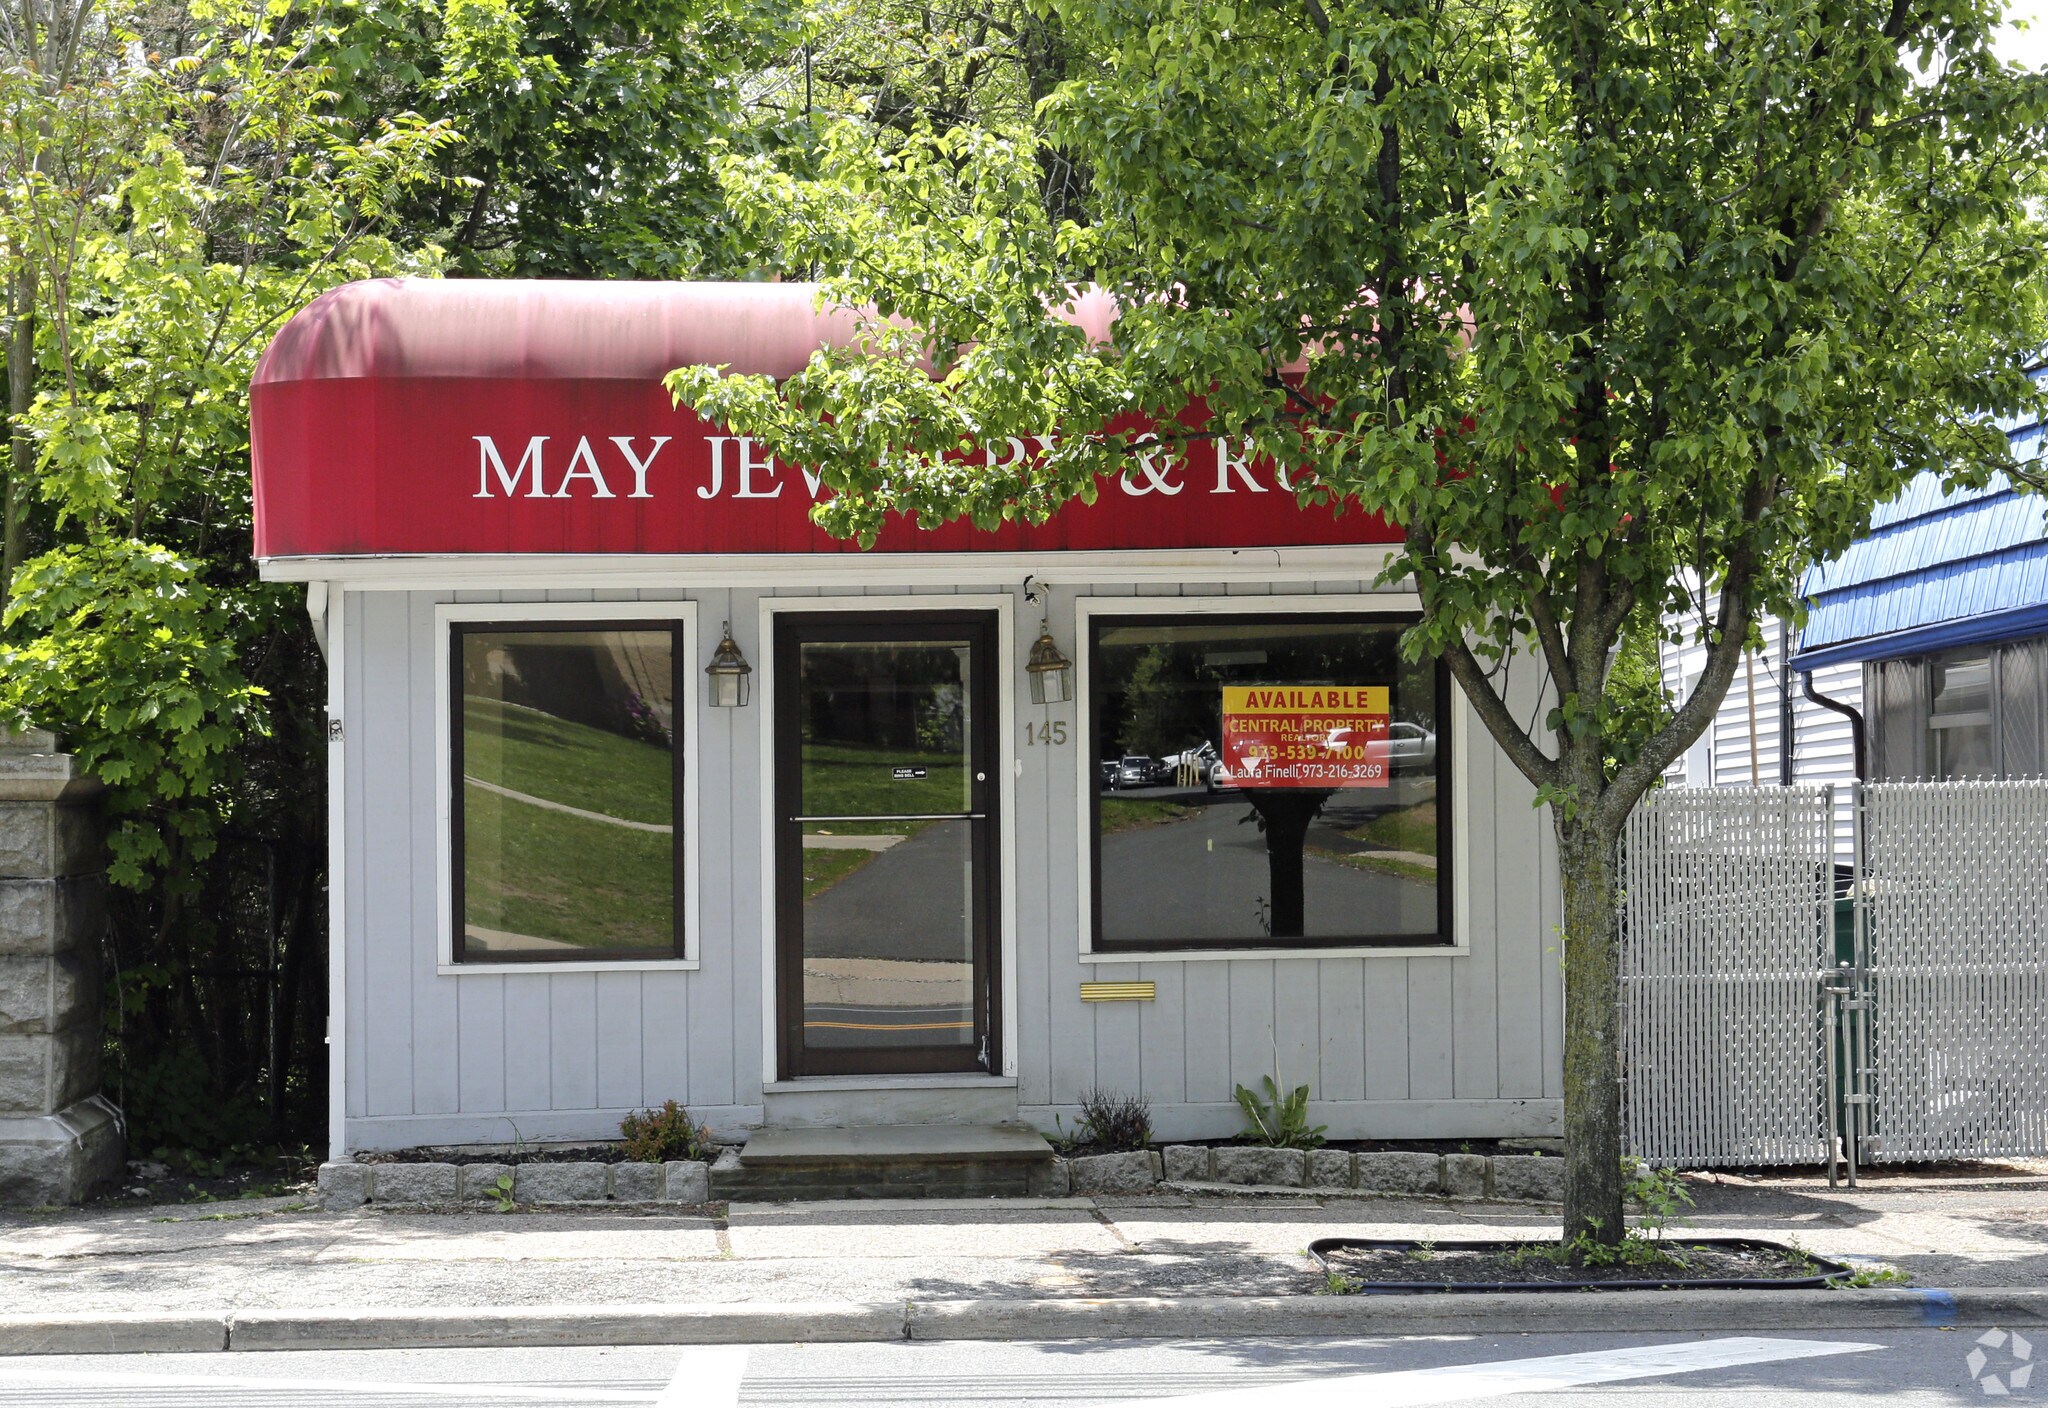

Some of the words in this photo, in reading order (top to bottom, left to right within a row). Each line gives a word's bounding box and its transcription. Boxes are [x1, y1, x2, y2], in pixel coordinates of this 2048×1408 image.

[472, 435, 672, 498] MAY
[1121, 432, 1184, 496] &
[1246, 691, 1368, 708] AVAILABLE
[1025, 720, 1067, 746] 145
[1229, 720, 1299, 733] CENTRAL
[1303, 719, 1384, 733] PROPERTY
[1281, 733, 1334, 742] REALTOR
[1249, 745, 1364, 760] 973-539-7100
[1230, 764, 1262, 778] Laura
[1265, 764, 1299, 778] Finelli
[1303, 764, 1382, 778] 973-216-3269
